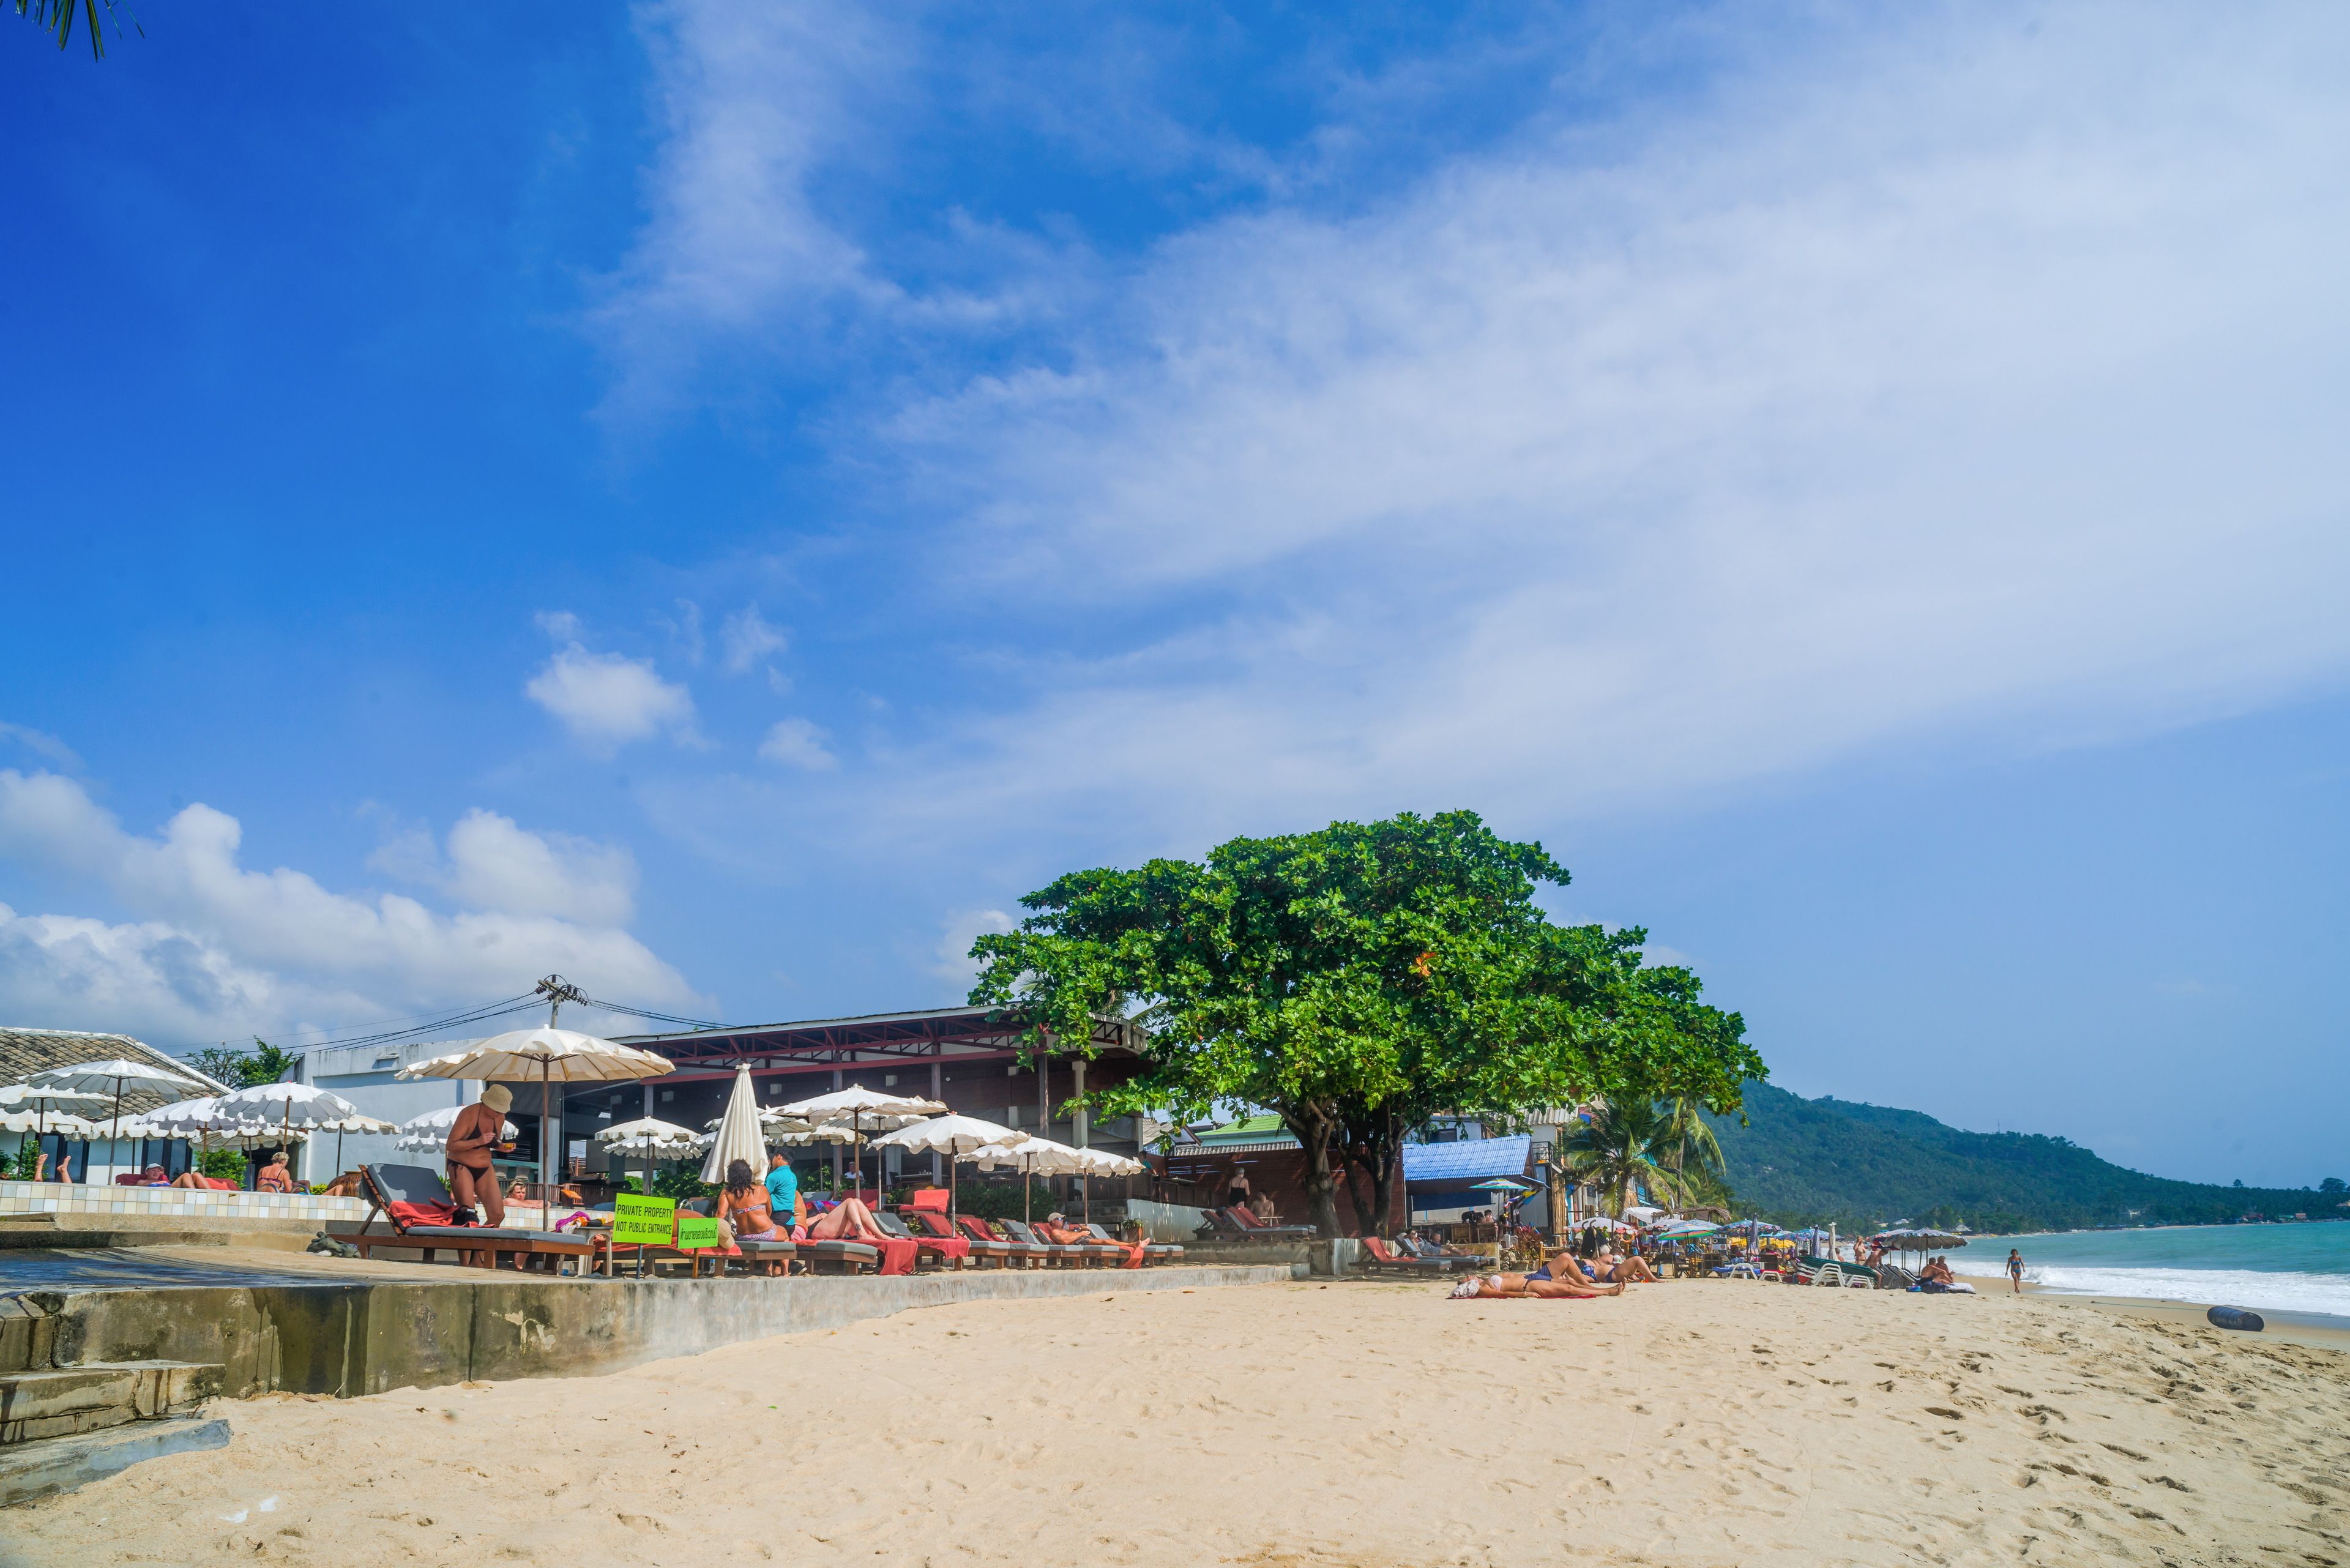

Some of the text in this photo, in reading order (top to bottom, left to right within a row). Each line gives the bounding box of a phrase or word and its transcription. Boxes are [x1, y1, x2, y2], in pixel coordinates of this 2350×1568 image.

[617, 1204, 673, 1218] PRIVATE PROPERTY
[616, 1222, 672, 1234] NOT PUBLIC ENTRANCE
